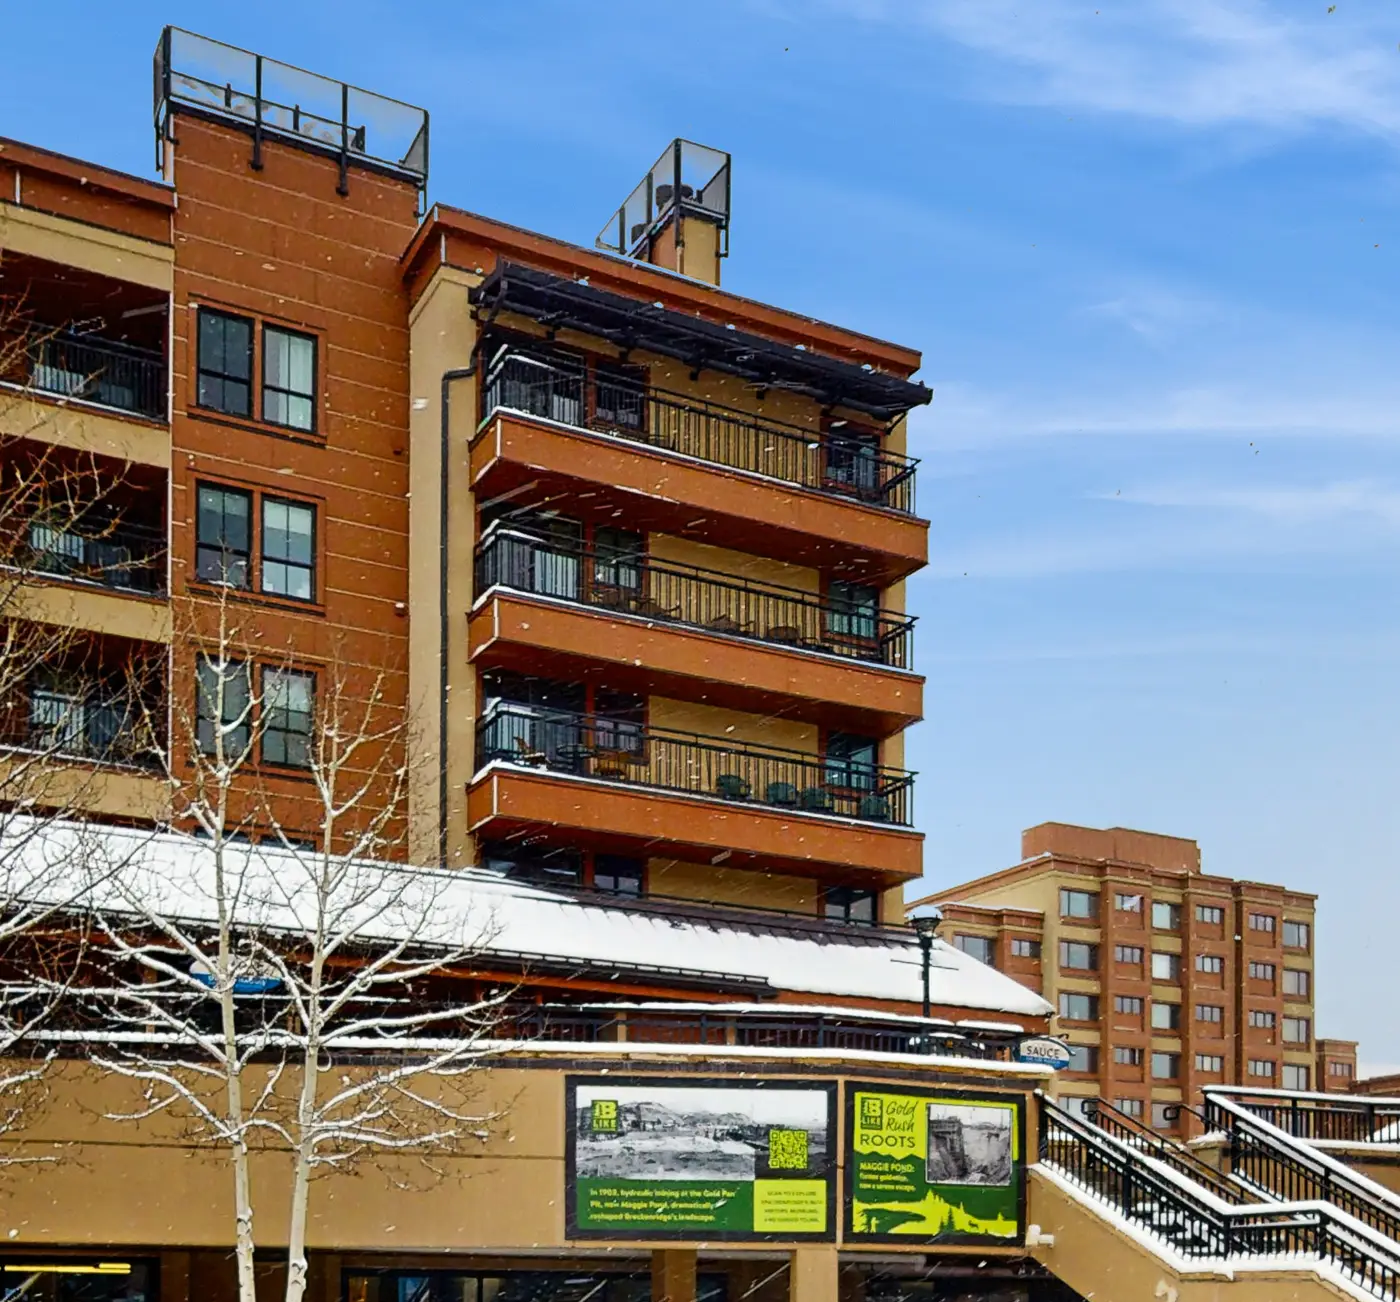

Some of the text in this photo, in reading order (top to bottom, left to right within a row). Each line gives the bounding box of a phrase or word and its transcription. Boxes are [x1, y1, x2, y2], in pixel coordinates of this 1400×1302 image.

[1026, 1045, 1060, 1059] SAUCE
[886, 1100, 919, 1117] Gold
[593, 1119, 617, 1129] LIKE
[886, 1116, 915, 1132] Rush
[860, 1133, 916, 1148] ROOTS
[859, 1162, 889, 1172] MAGGIE
[689, 1189, 702, 1197] the
[703, 1188, 721, 1197] Gold
[620, 1201, 649, 1210] Maggie
